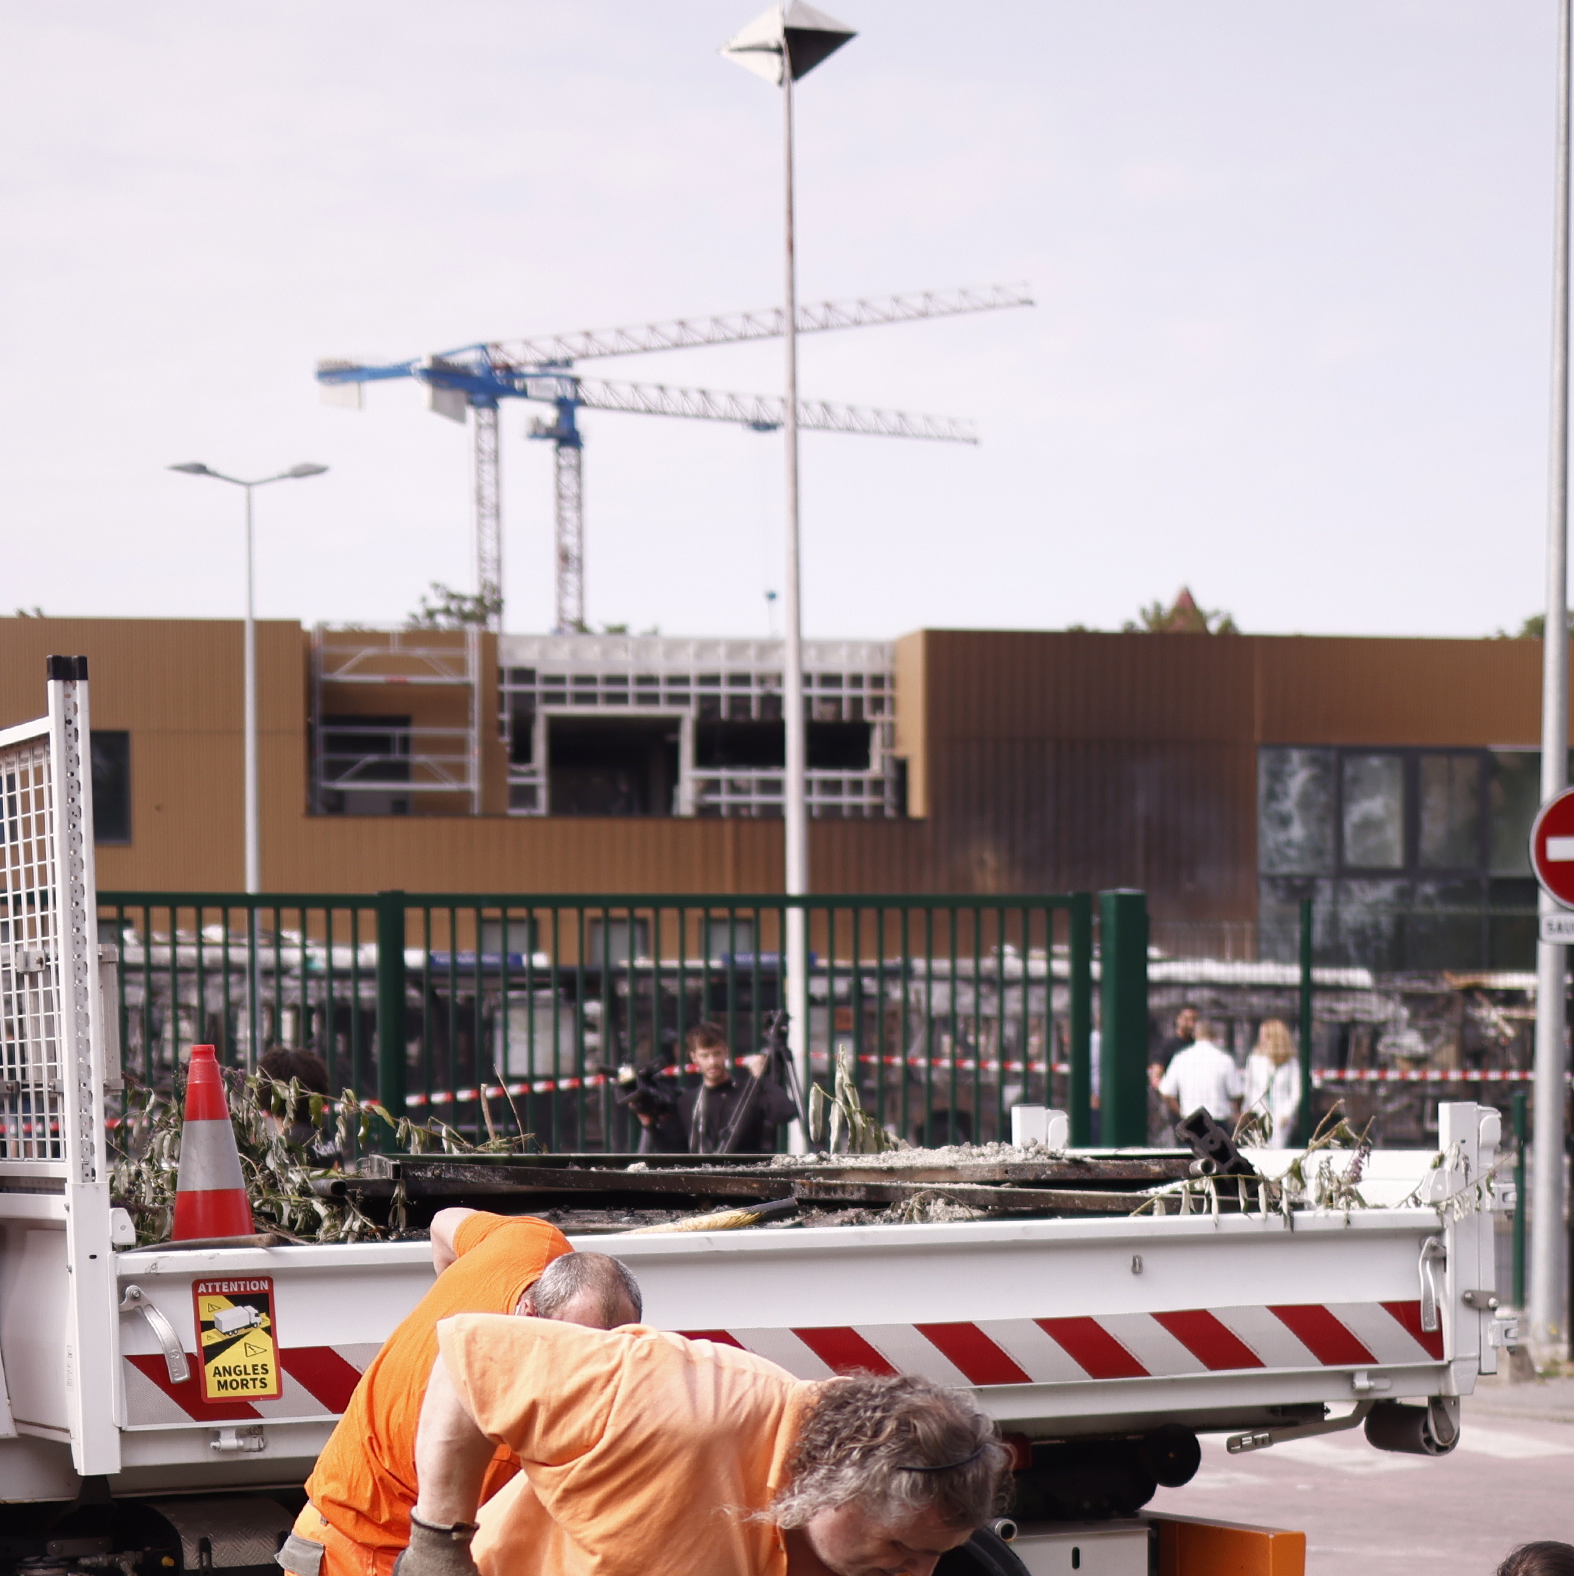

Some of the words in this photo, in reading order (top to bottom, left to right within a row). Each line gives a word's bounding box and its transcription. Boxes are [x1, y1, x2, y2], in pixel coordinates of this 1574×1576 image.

[197, 1280, 269, 1294] ATTENTION
[212, 1363, 269, 1378] ANGLES
[216, 1378, 268, 1392] MORTS
